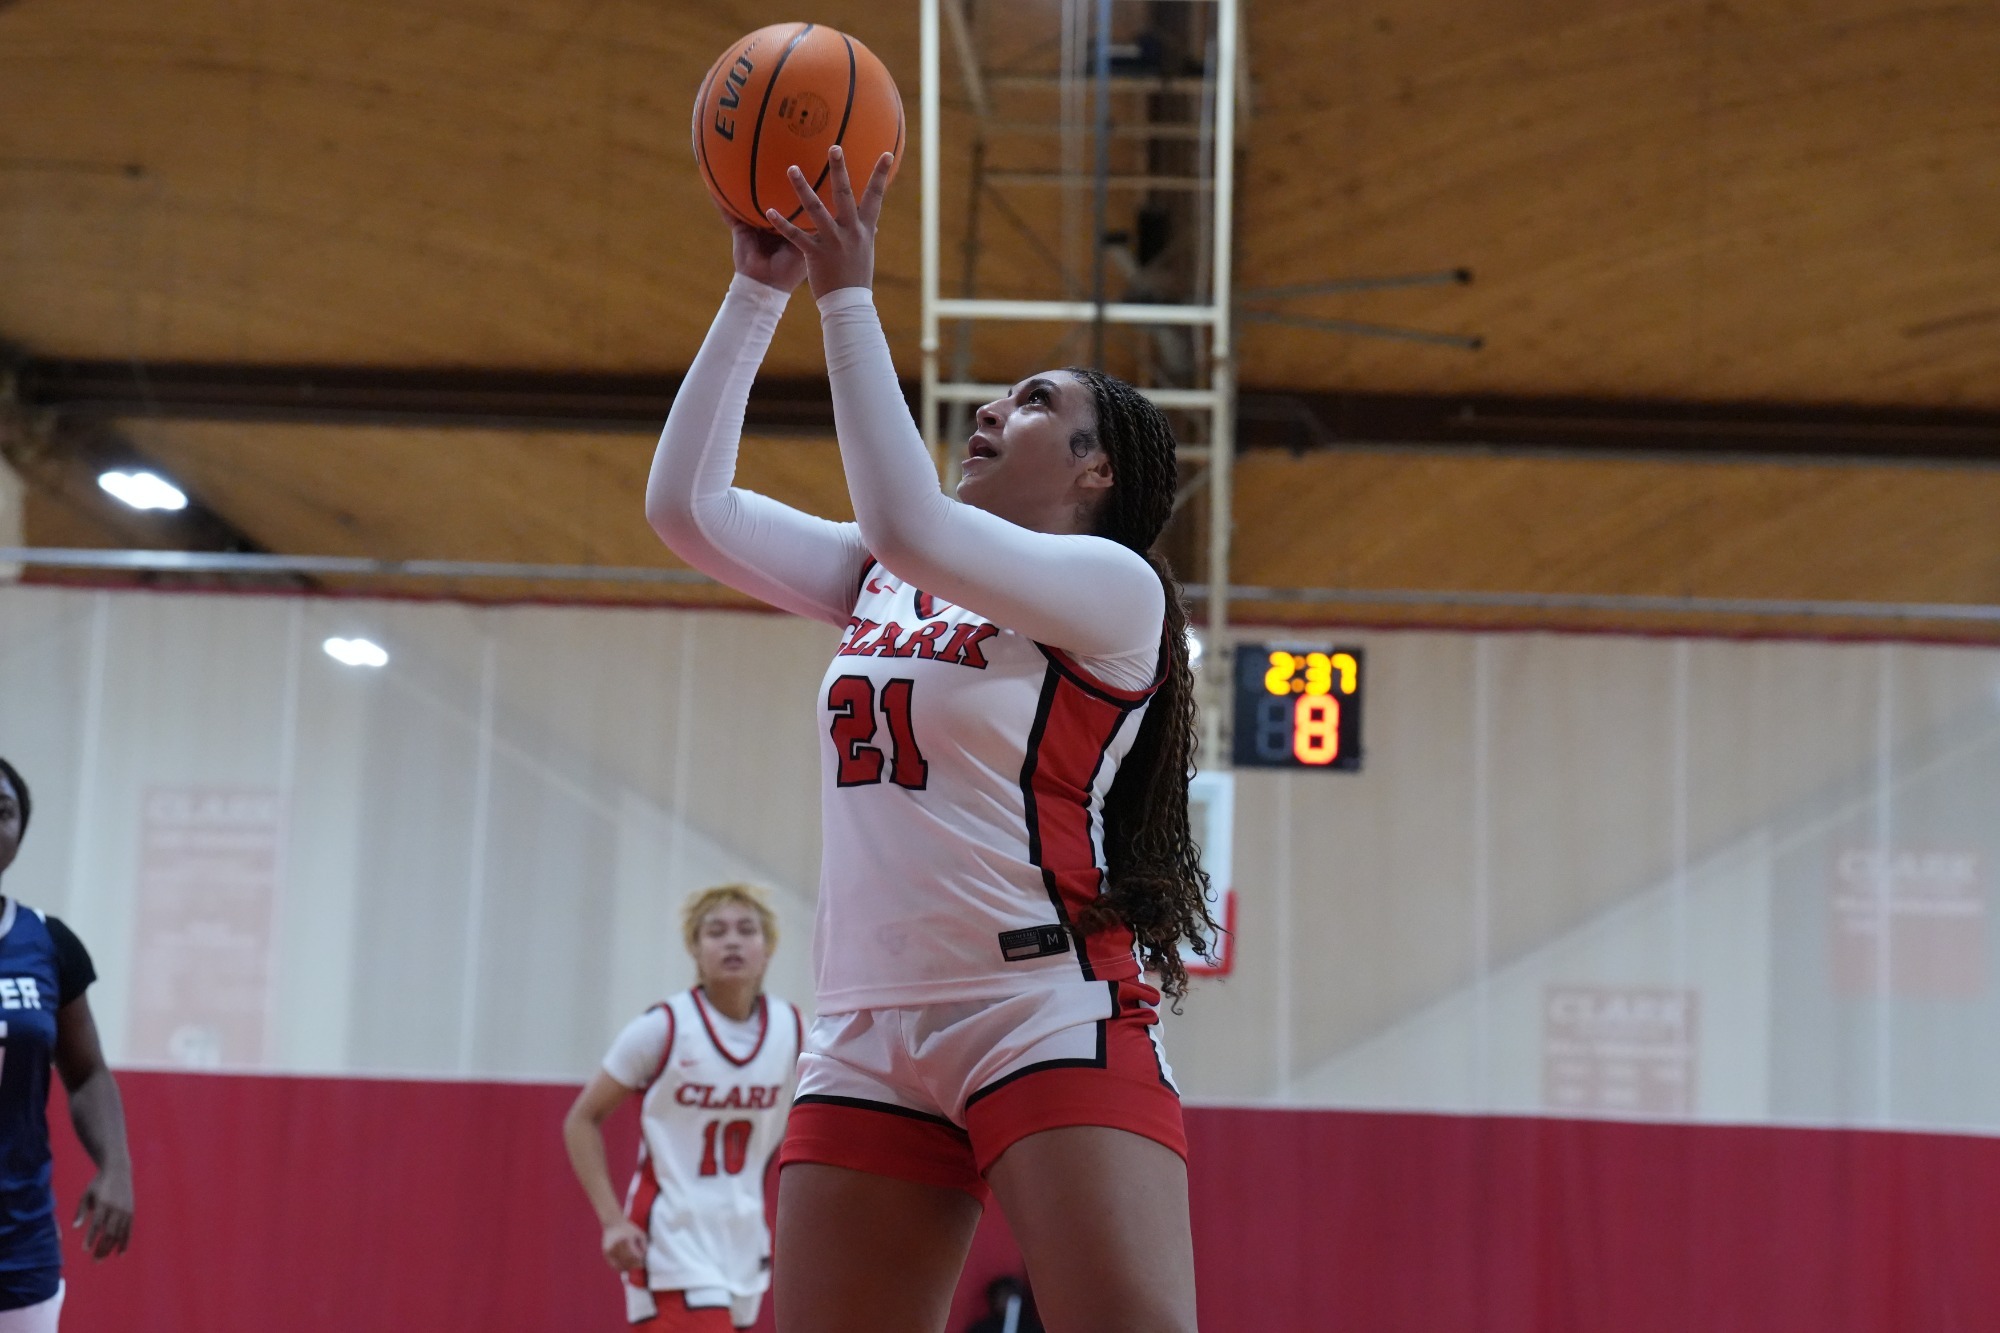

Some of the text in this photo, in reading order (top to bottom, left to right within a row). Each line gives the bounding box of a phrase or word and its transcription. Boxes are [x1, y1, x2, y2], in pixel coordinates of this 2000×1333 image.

[1265, 651, 1357, 695] 2:37
[827, 674, 929, 791] 21
[1293, 691, 1340, 765] 8
[1046, 932, 1059, 946] M
[699, 1119, 754, 1177] 10
